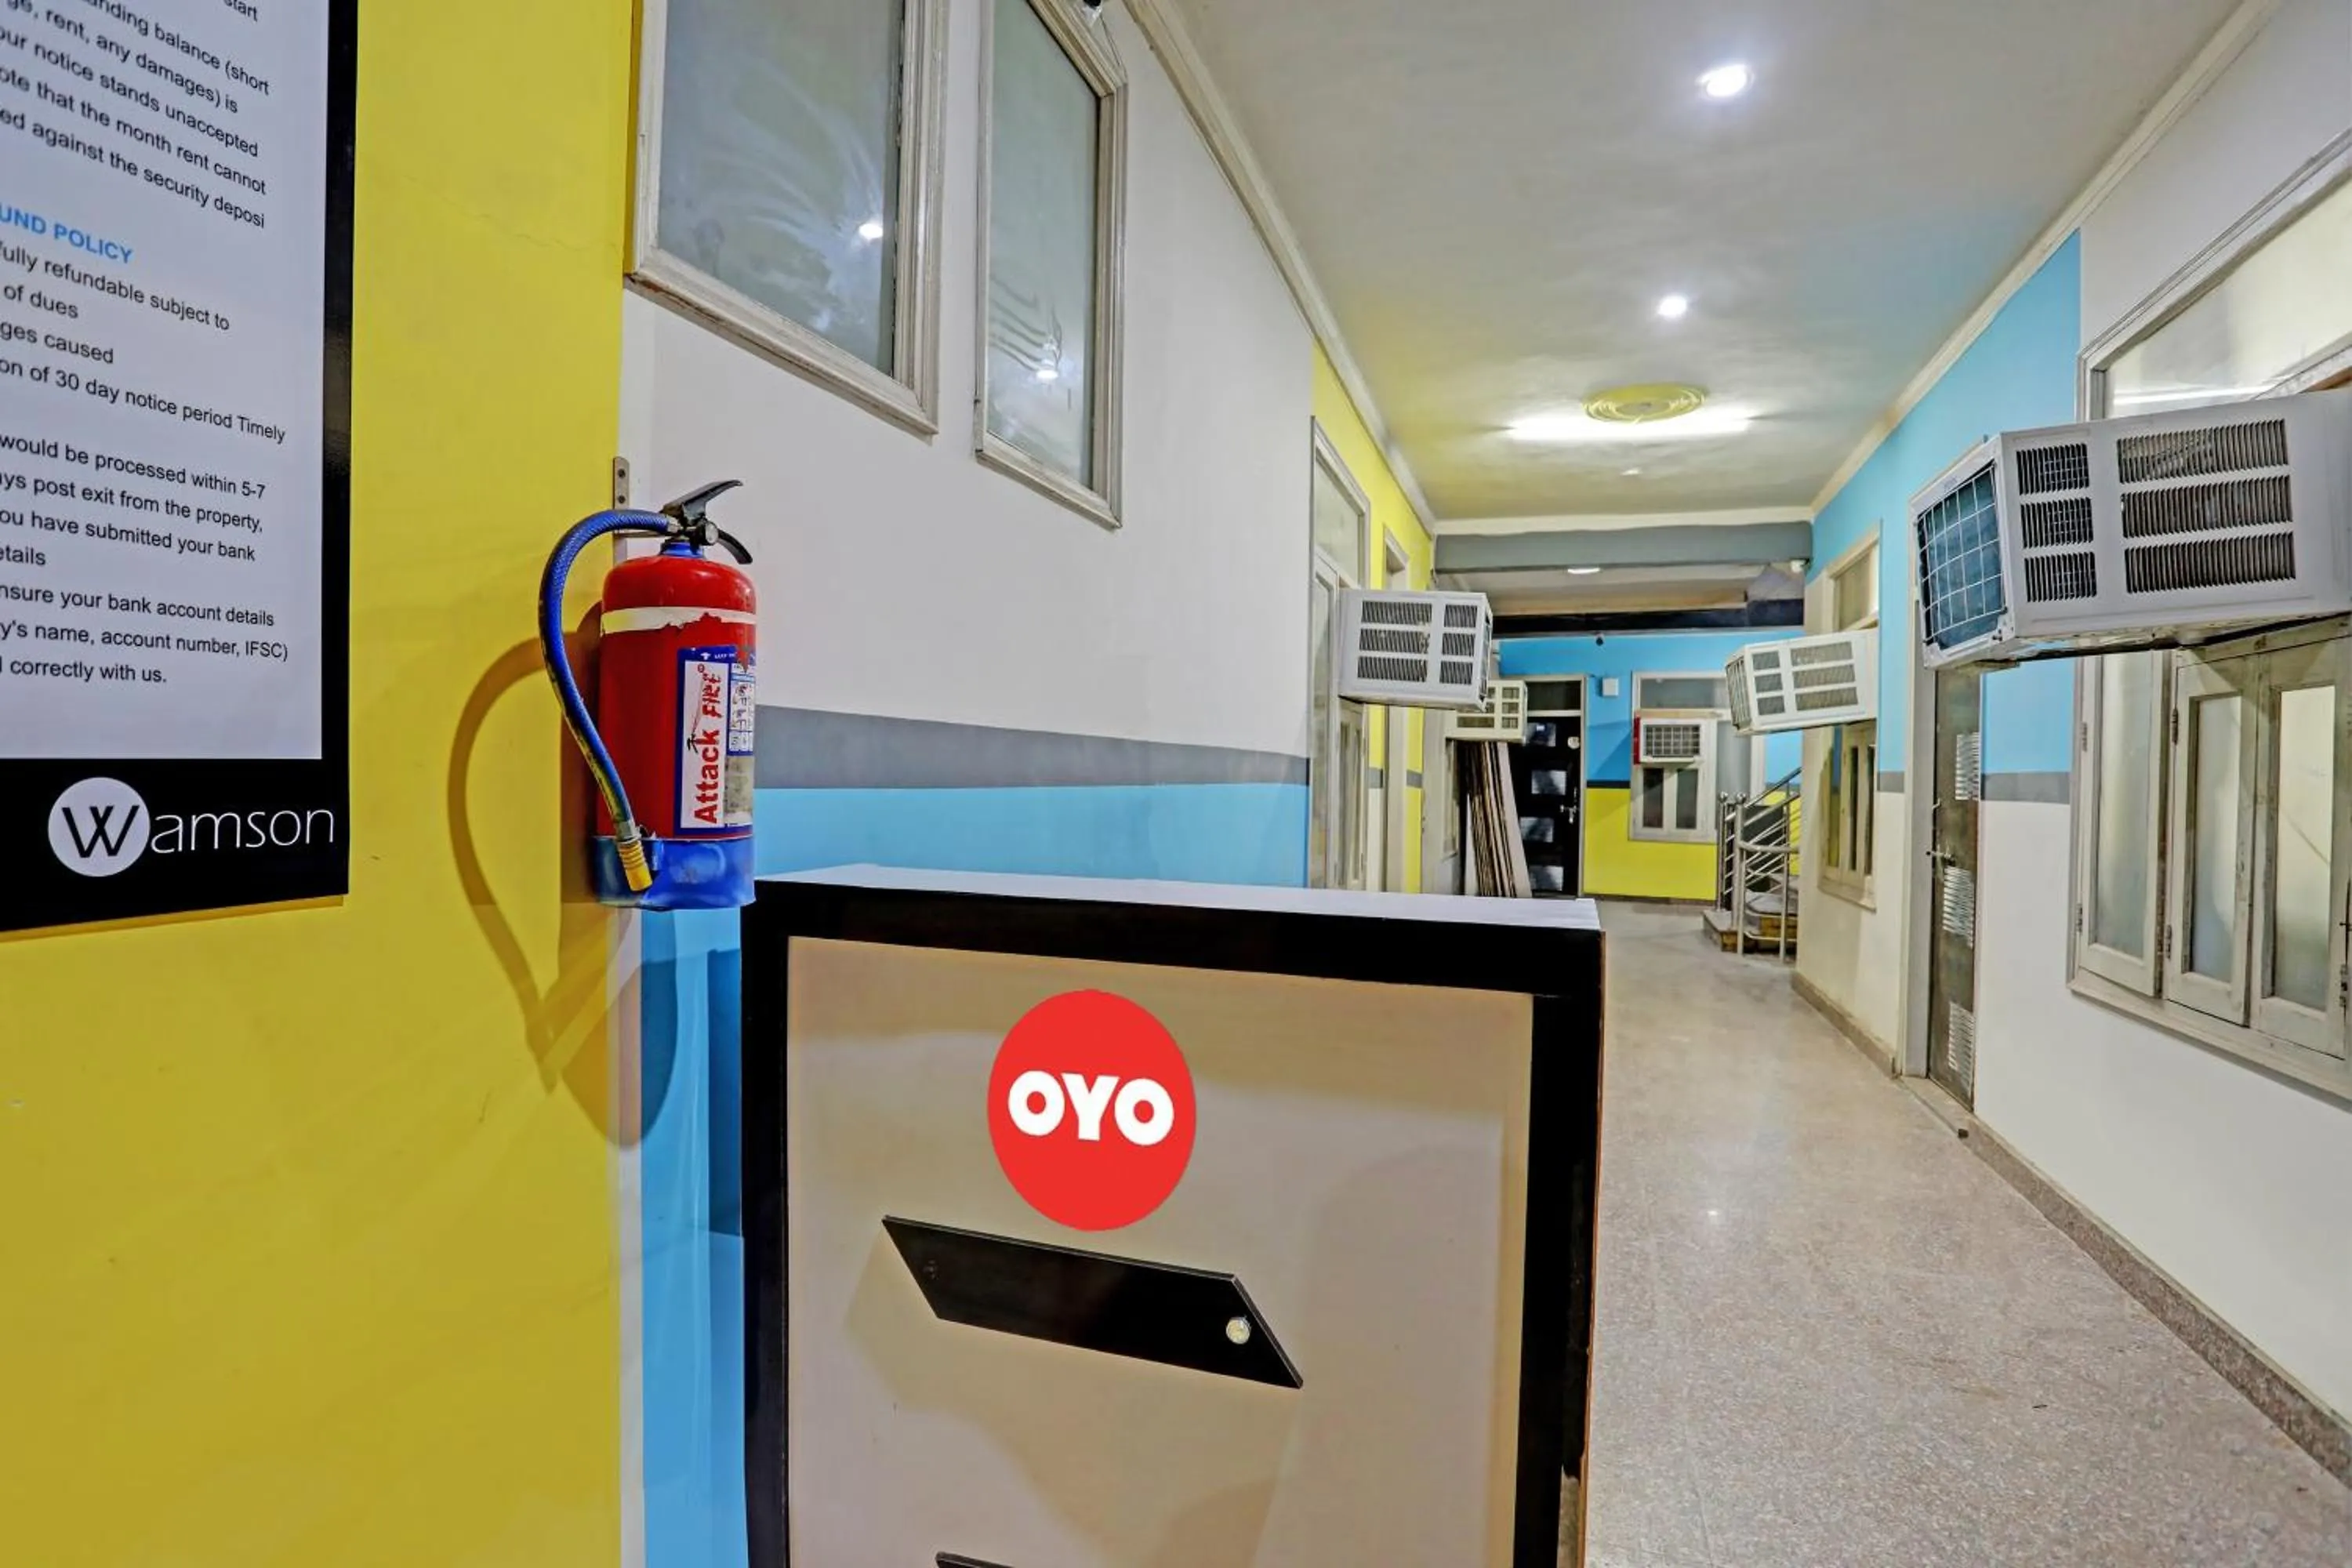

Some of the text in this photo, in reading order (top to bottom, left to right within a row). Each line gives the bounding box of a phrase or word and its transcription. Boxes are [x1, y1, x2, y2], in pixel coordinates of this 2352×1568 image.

[46, 9, 89, 44] rent,
[96, 35, 130, 63] any
[136, 53, 220, 108] damages)
[226, 94, 238, 113] is
[155, 23, 220, 69] balance
[226, 60, 269, 96] (short
[34, 44, 93, 81] notice
[100, 75, 160, 111] stands
[165, 104, 258, 157] unaccepted
[38, 82, 74, 112] that
[80, 100, 110, 127] the
[116, 119, 171, 154] month
[177, 146, 209, 171] rent
[213, 163, 266, 195] cannot
[32, 123, 103, 163] against
[110, 151, 138, 176] the
[144, 169, 209, 208] security
[214, 196, 264, 229] deposi
[0, 204, 132, 263] UND POLICY
[3, 285, 78, 318] of dues
[45, 261, 144, 303] refundable
[151, 295, 210, 325] subject
[215, 314, 229, 330] to
[0, 321, 113, 364] ges caused
[0, 359, 285, 445] on of 30 day notice period Timely
[0, 434, 265, 499] would be processed within 5-7
[0, 473, 262, 533] ys post exit from the property,
[0, 510, 255, 561] ou have submitted your bank
[60, 591, 103, 609] your
[108, 593, 152, 614] bank
[157, 602, 221, 621] account
[226, 607, 274, 626] details
[10, 660, 94, 682] correctly
[99, 663, 136, 681] with
[142, 669, 166, 682] us.
[34, 626, 94, 645] name,
[101, 631, 171, 649] account
[176, 638, 240, 657] number,
[245, 641, 288, 662] IFSC)
[693, 729, 720, 825] Attack
[1007, 1069, 1174, 1147] OYO
